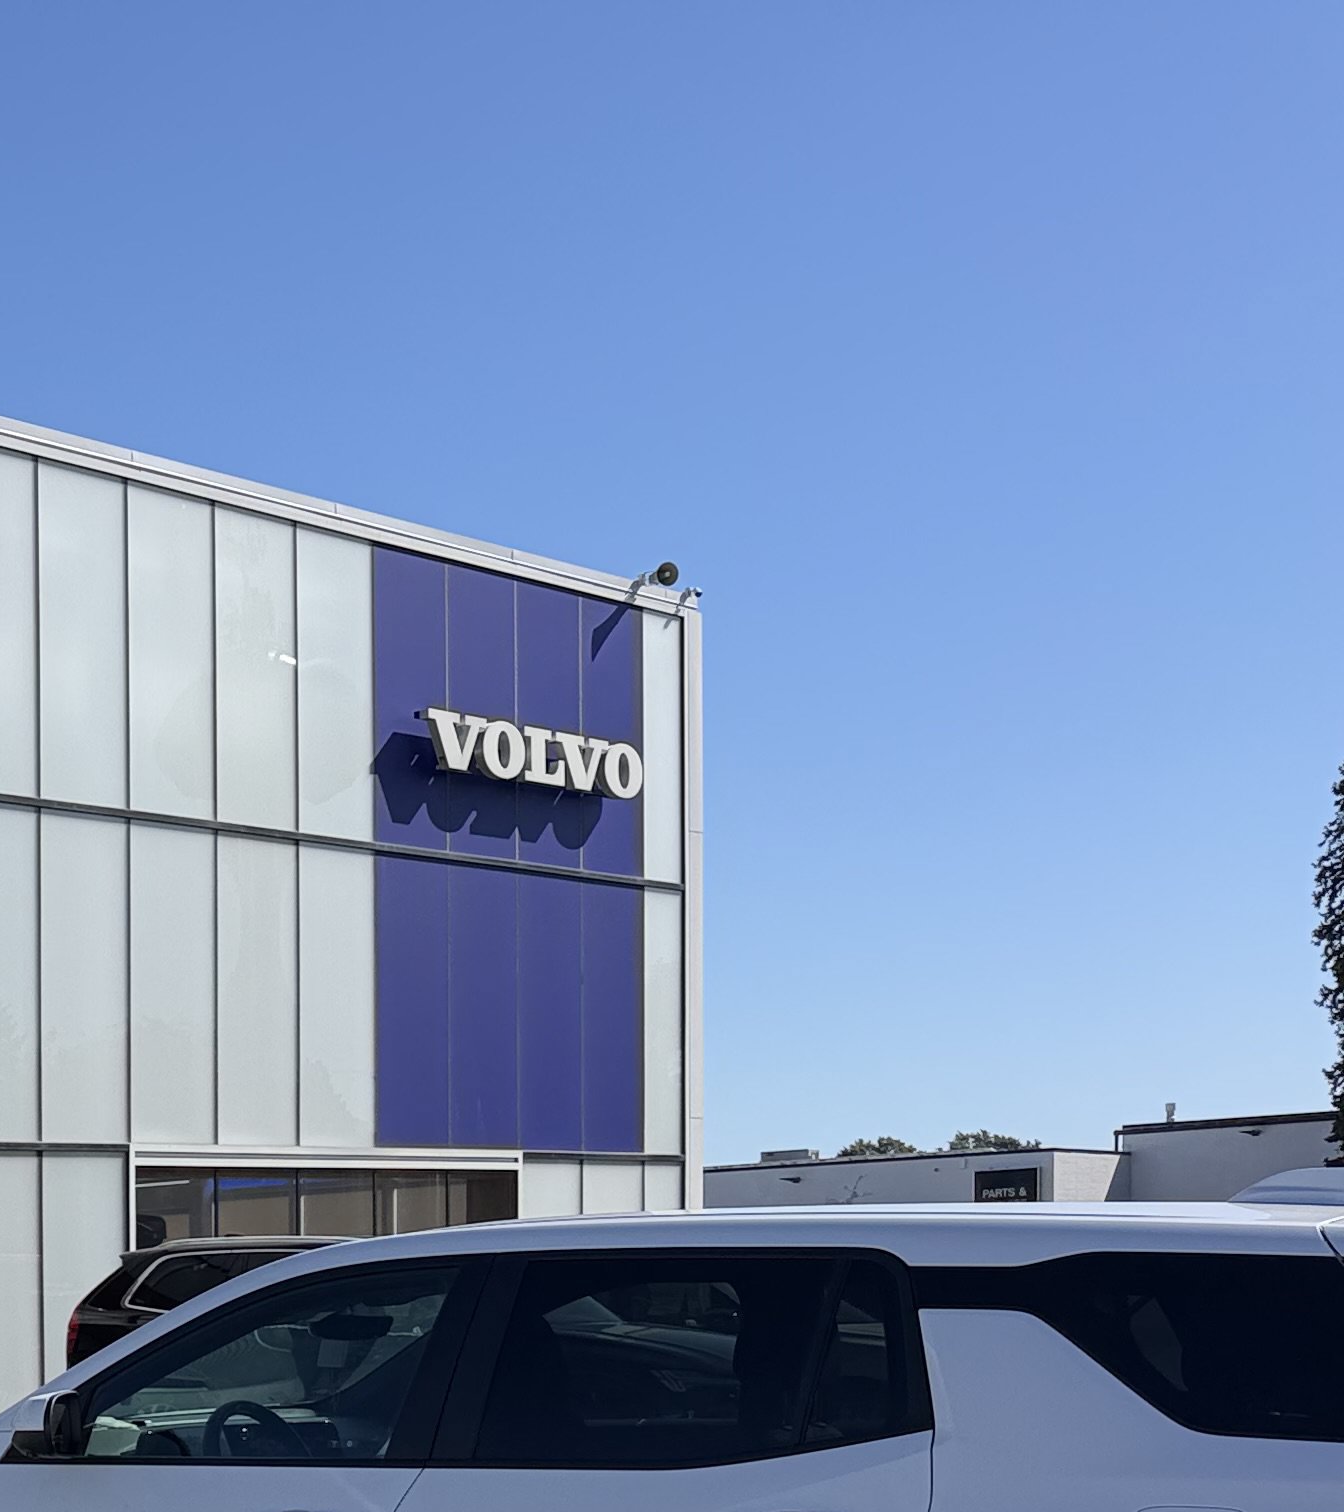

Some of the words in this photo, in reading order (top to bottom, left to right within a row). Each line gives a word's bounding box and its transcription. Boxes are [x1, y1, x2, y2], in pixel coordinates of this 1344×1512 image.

[424, 707, 643, 799] VOLVO
[982, 1187, 1015, 1199] PARTS
[1018, 1186, 1027, 1197] &
